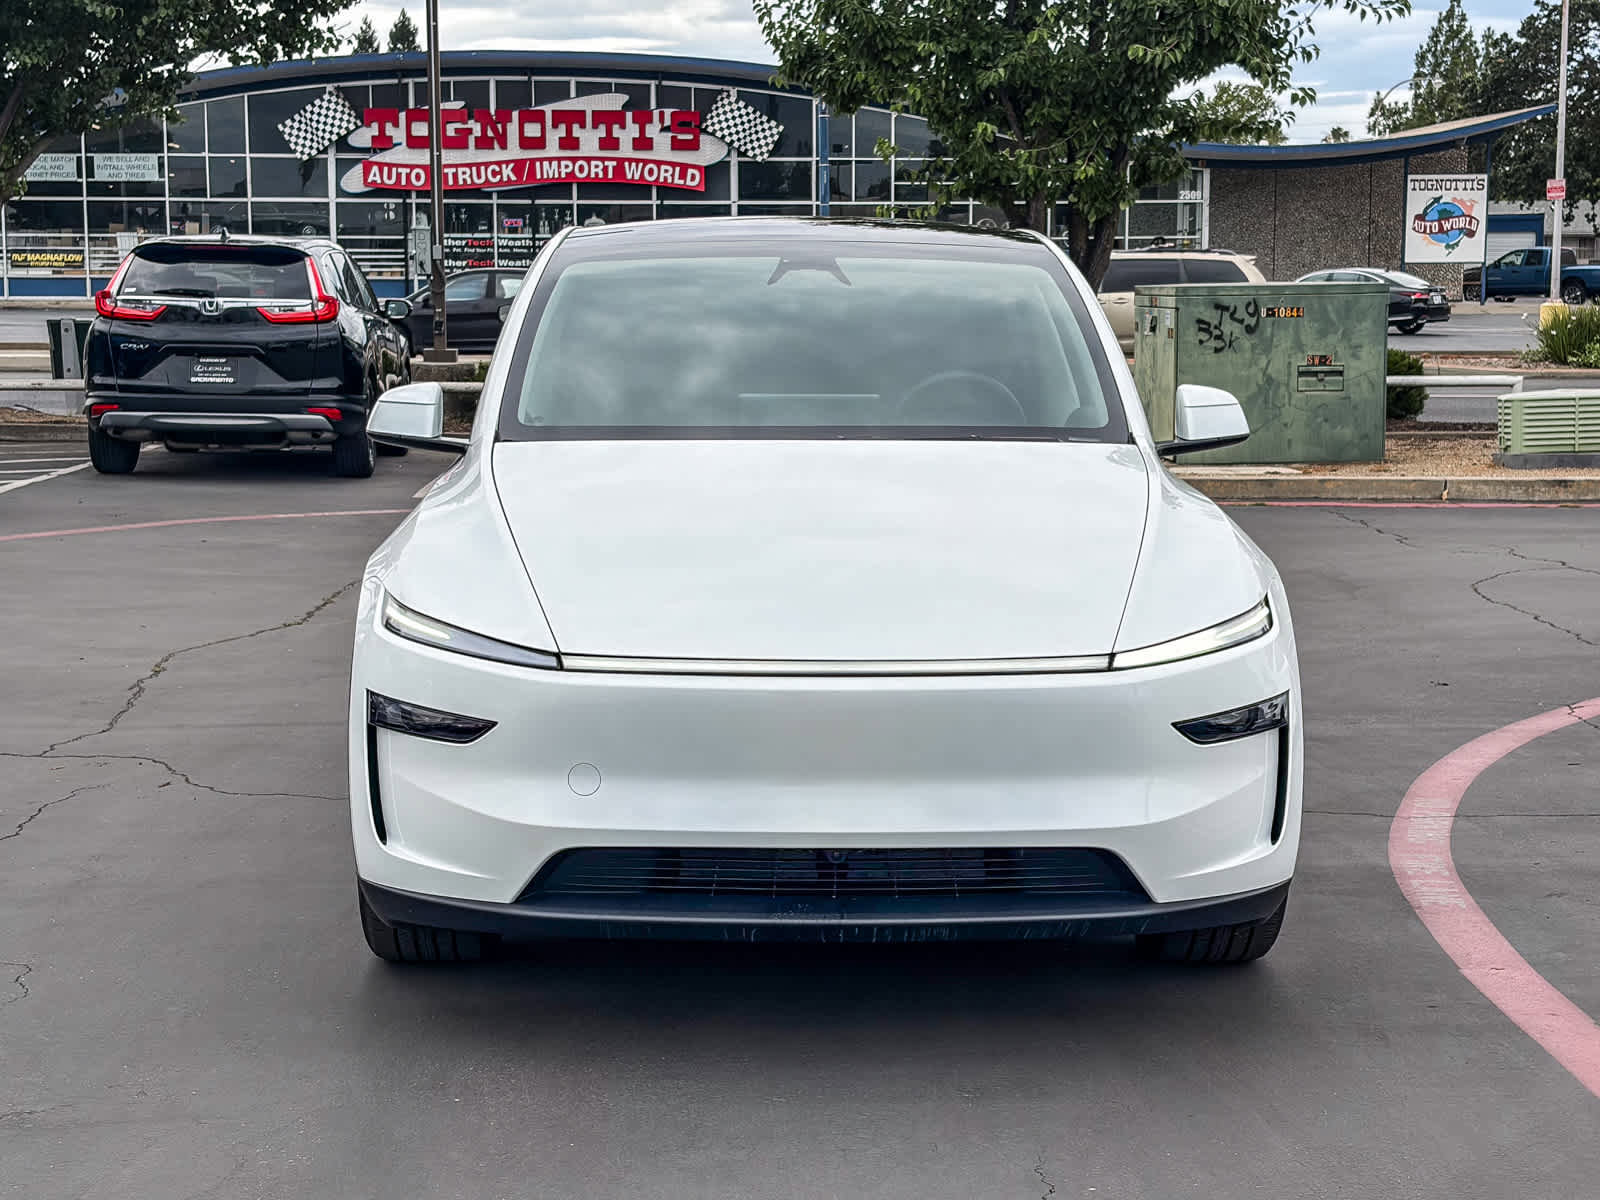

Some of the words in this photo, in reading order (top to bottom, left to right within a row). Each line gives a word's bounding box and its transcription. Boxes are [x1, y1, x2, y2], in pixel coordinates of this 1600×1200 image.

[364, 108, 700, 151] TOGNOTTI'S
[96, 163, 124, 171] INSTALL
[367, 165, 426, 187] AUTO
[443, 162, 517, 186] TRUCK
[535, 160, 617, 180] IMPORT
[624, 161, 701, 187] WORLD
[1410, 176, 1485, 192] TOGNOTTI'S
[1413, 219, 1439, 234] AUTO
[1441, 216, 1478, 232] WORLD
[1261, 307, 1304, 318] U-10844
[1306, 355, 1332, 366] SW-2
